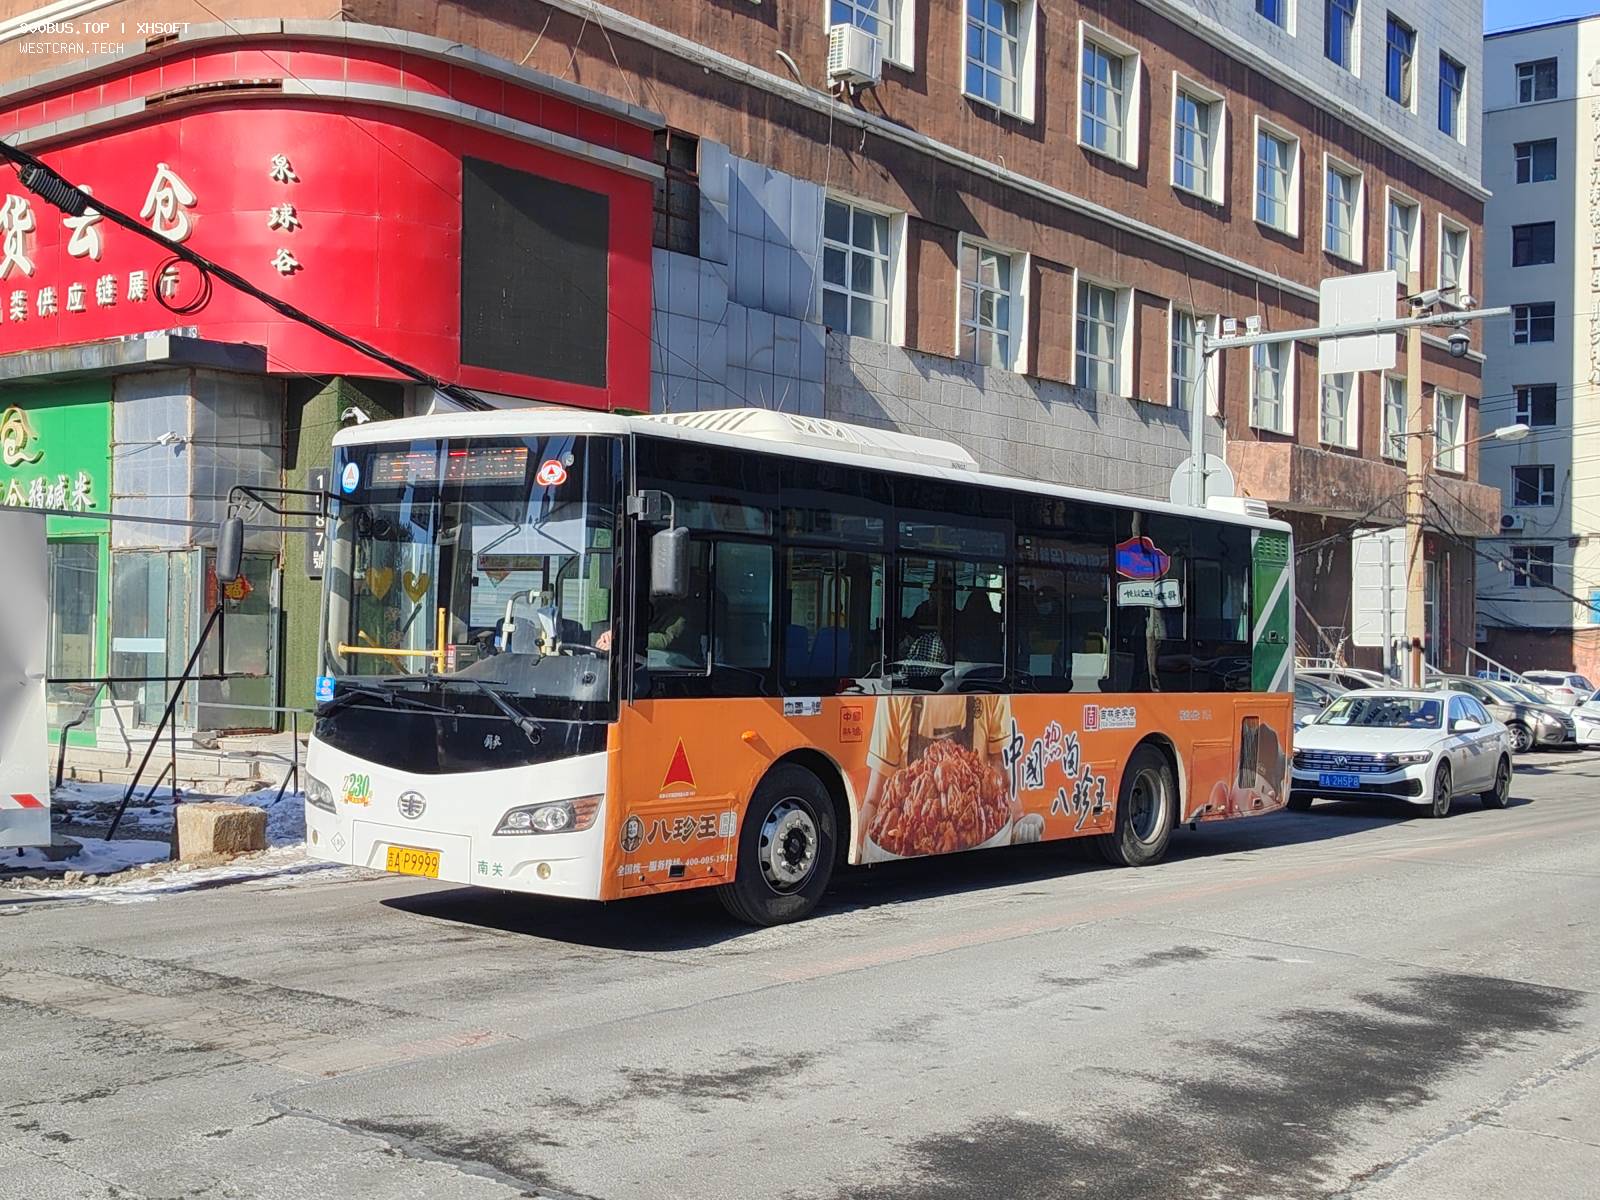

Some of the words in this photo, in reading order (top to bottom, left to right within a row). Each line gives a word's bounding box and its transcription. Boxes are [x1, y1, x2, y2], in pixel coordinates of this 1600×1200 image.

[0, 267, 179, 324] 类供应链展厅
[646, 814, 718, 844] 八珍王
[477, 860, 504, 877] 南关
